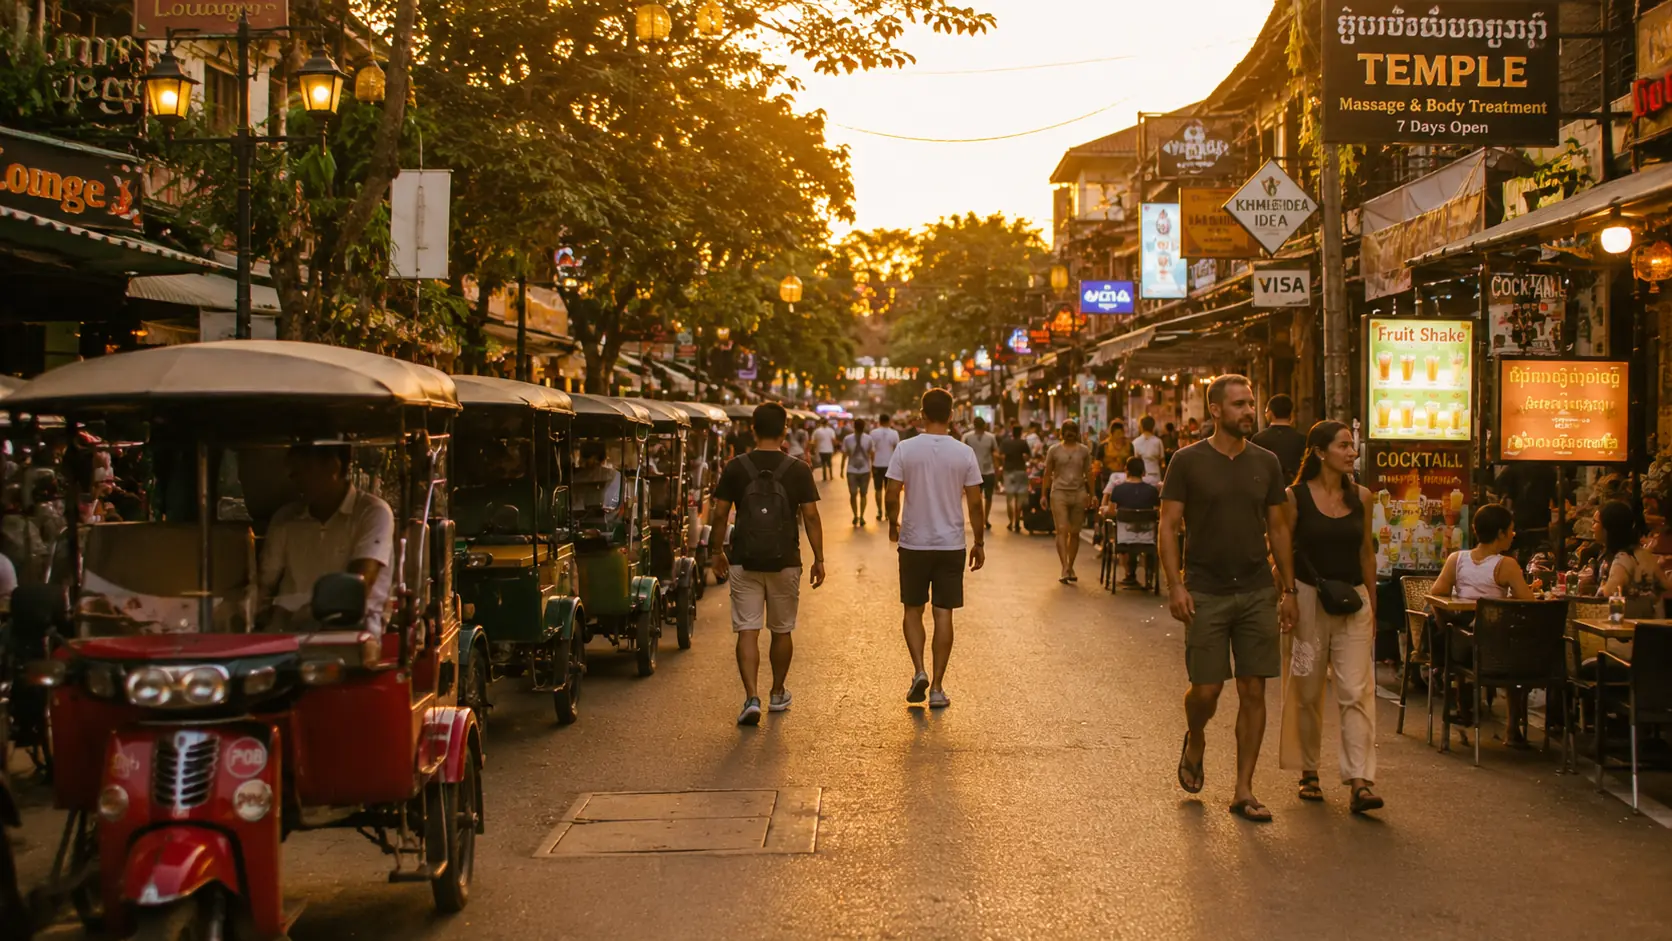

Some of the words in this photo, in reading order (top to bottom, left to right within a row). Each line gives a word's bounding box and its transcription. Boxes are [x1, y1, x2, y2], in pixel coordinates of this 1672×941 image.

[1357, 54, 1528, 88] TEMPLE
[1339, 97, 1405, 115] Massage
[1409, 98, 1422, 113] &
[1426, 98, 1465, 116] Body
[1468, 99, 1548, 115] Treatment
[1396, 120, 1406, 133] 7
[1410, 120, 1446, 136] Days
[1450, 120, 1489, 136] Open
[1255, 214, 1288, 228] IDEA
[1258, 277, 1305, 294] VISA
[1378, 326, 1415, 342] Fruit
[1420, 327, 1466, 342] Shake
